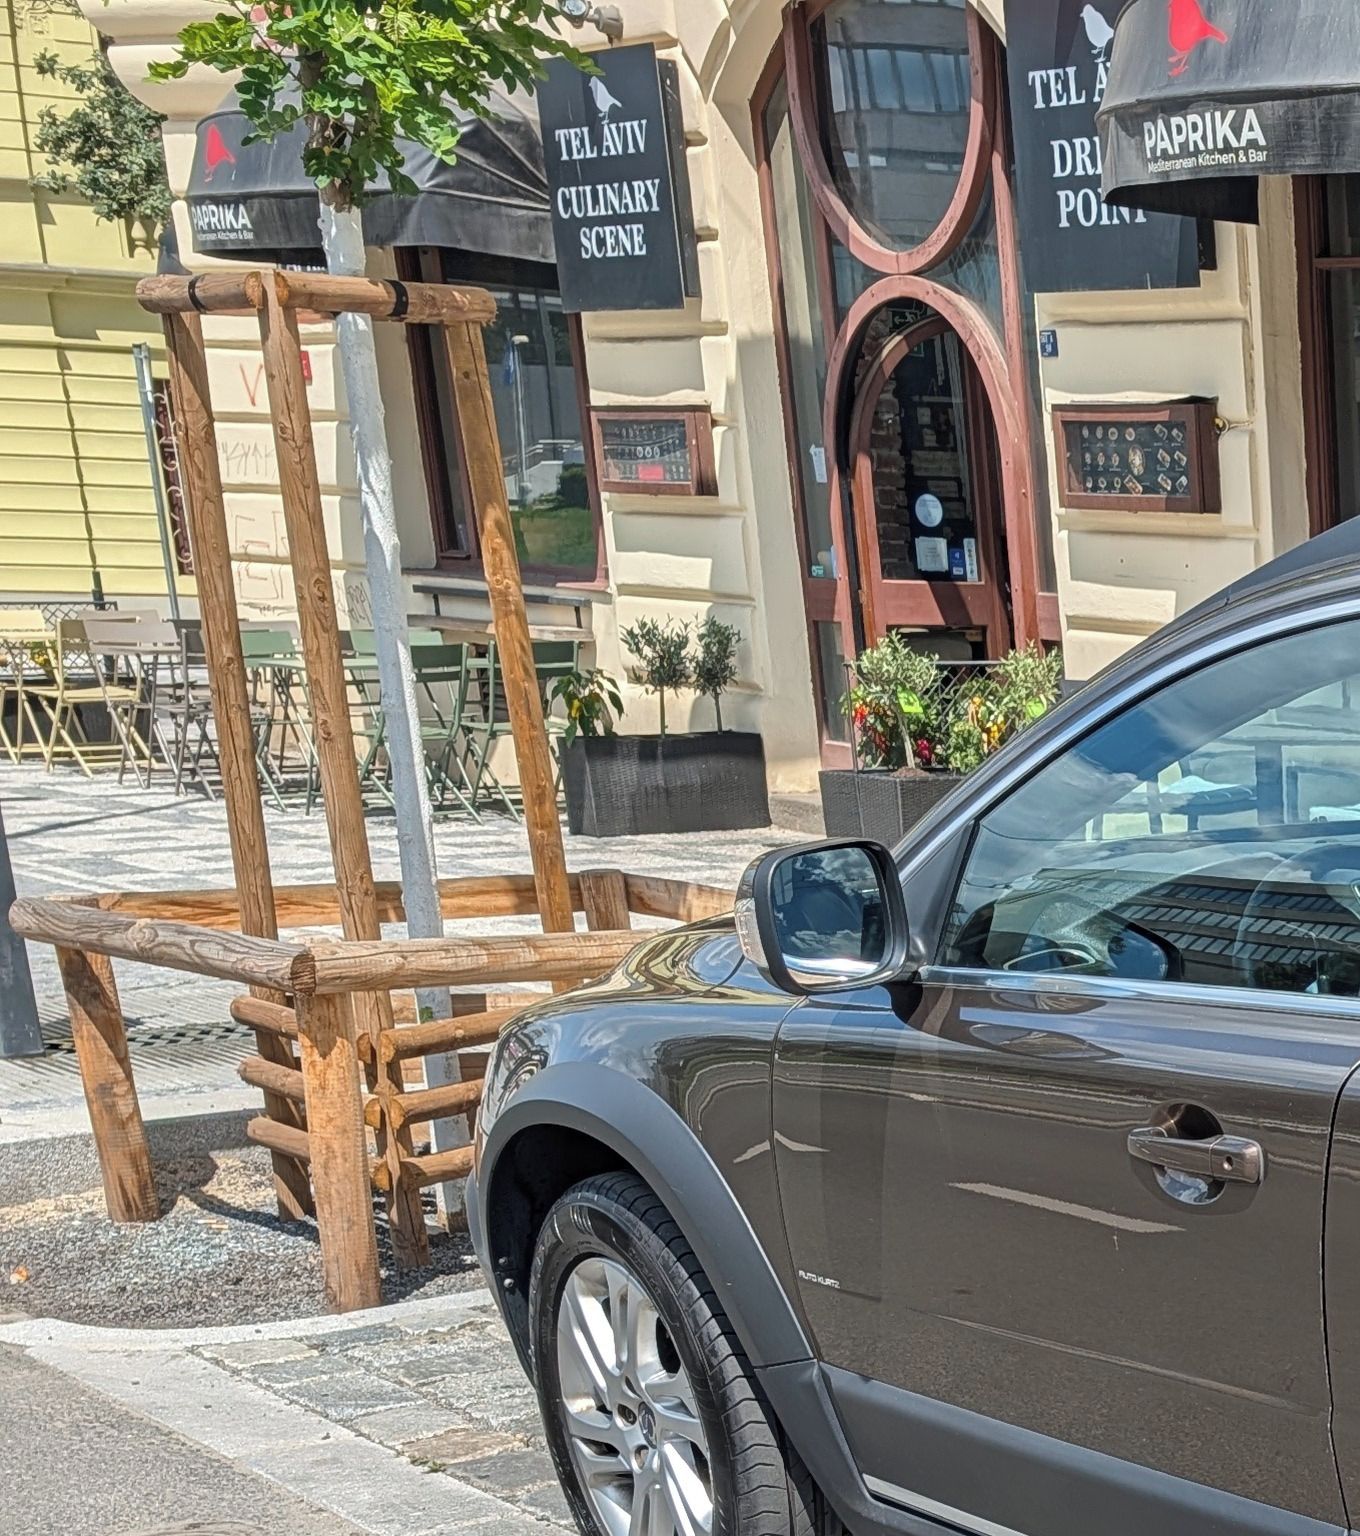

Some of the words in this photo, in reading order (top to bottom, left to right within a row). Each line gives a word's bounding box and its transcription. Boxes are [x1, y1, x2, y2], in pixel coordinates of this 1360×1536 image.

[1028, 66, 1086, 109] TEL
[555, 127, 597, 161] TEL
[601, 119, 648, 157] AVIV
[1143, 109, 1267, 158] PAPRIKA
[1050, 135, 1103, 178] DRI
[1148, 157, 1197, 173] Mediterranean
[1198, 151, 1236, 166] Kitchen
[1238, 150, 1248, 163] &
[1248, 149, 1268, 162] Bar
[191, 203, 253, 231] PAPRIKA
[557, 178, 660, 219] CULINARY
[580, 224, 647, 259] SCENE
